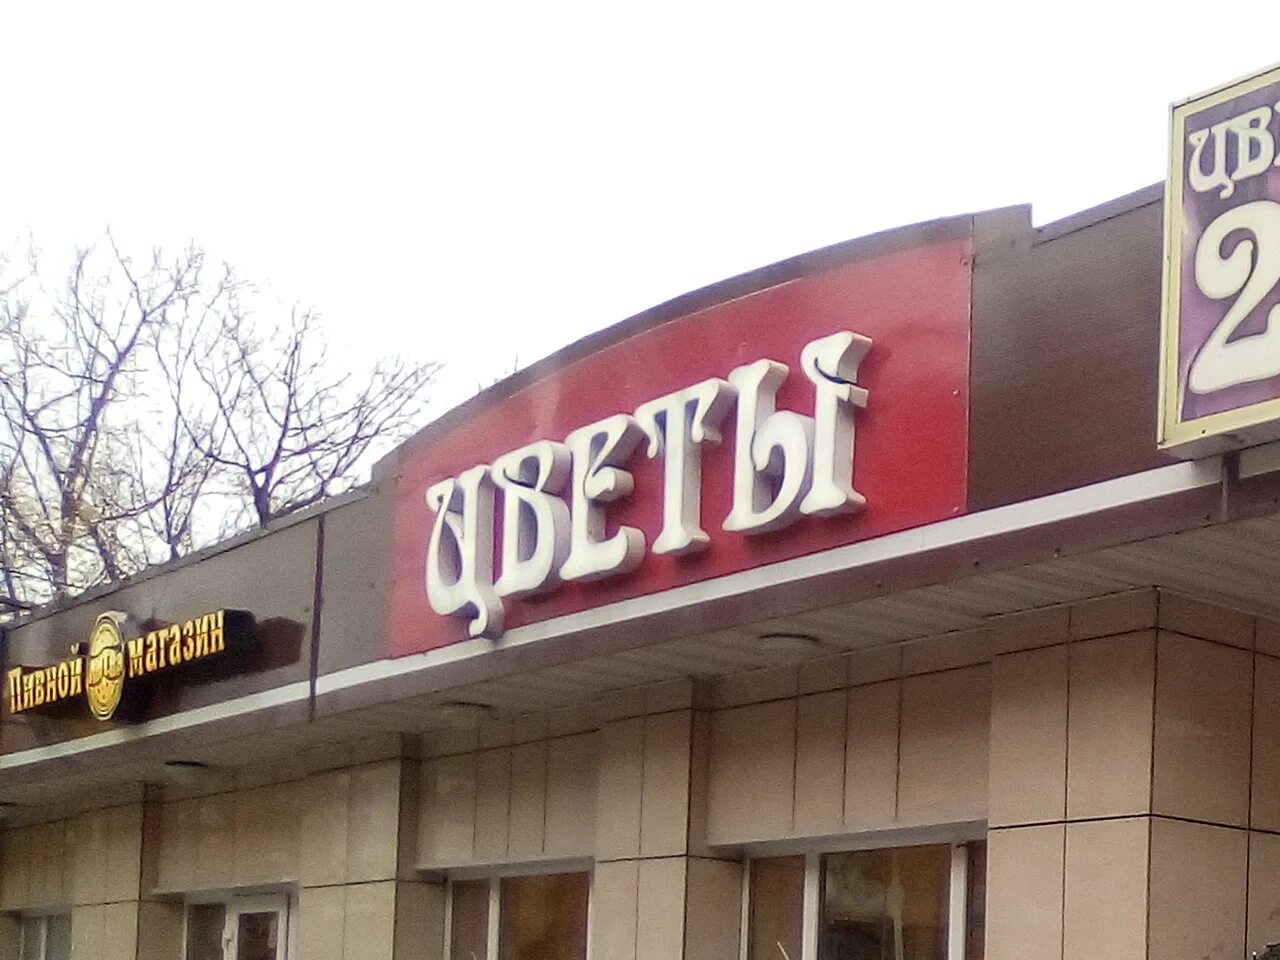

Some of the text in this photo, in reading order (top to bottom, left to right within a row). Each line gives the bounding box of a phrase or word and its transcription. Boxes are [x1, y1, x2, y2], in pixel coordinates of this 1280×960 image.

[425, 331, 873, 638] ЦВЕТЫ
[8, 609, 225, 713] Пивной магазин
